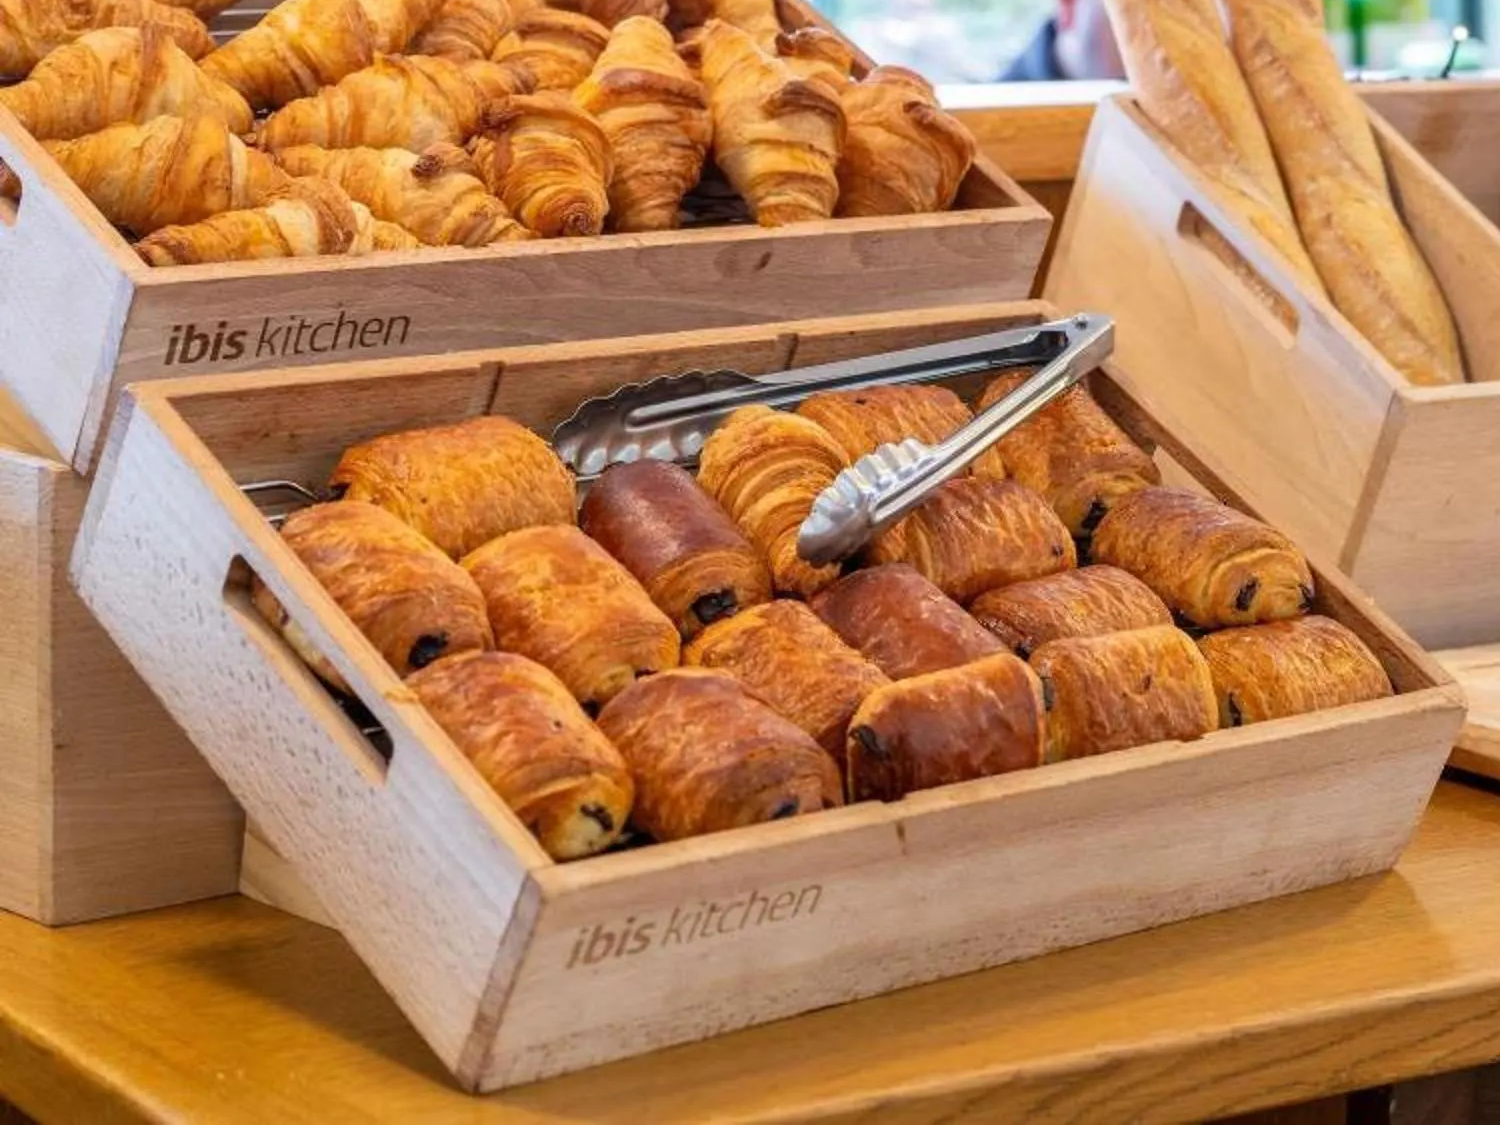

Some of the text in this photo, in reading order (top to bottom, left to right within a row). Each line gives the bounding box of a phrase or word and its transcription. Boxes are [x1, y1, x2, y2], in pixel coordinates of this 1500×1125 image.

[164, 309, 411, 365] ibis kitchen
[566, 883, 823, 970] ibis kitchen
